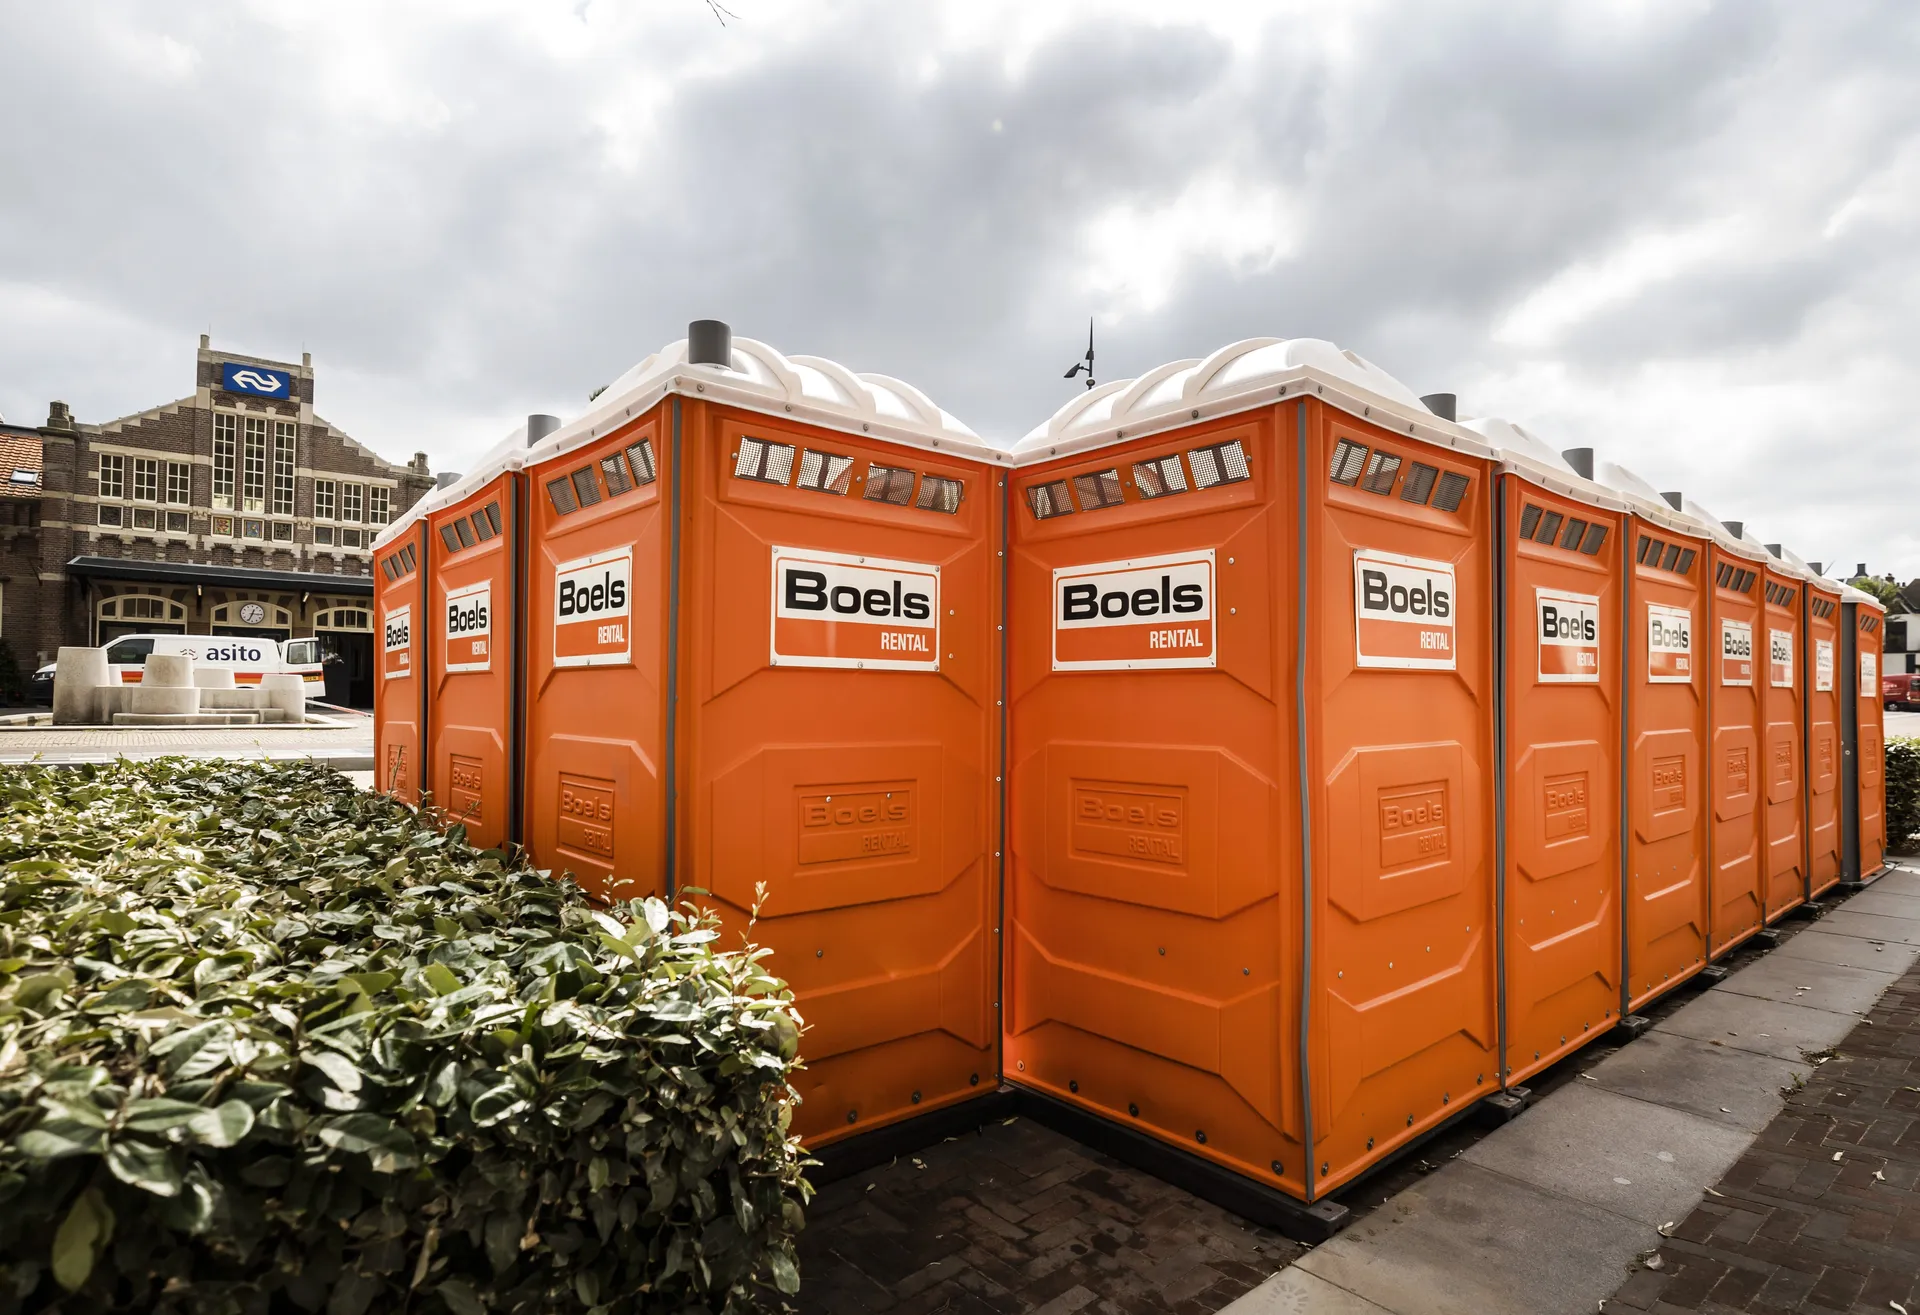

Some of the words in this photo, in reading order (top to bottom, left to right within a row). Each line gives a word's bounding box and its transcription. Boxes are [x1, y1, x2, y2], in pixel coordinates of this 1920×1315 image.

[559, 571, 626, 617] Boels
[785, 568, 930, 620] Boels
[1063, 575, 1204, 621] Boels
[1362, 569, 1450, 618] Boels
[448, 600, 488, 633] Boels
[1542, 605, 1595, 641] Boels
[386, 620, 409, 647] Boels
[597, 623, 625, 645] RENTAL
[880, 632, 929, 652] RENTAL
[1149, 628, 1203, 649] RENTAL
[1420, 631, 1449, 651] RENTAL
[1652, 620, 1689, 648] Boels
[1724, 632, 1750, 656] Boels
[206, 643, 261, 662] asito
[562, 789, 611, 821] Boels
[1546, 786, 1585, 810] Boels
[803, 801, 908, 828] Boels
[1078, 799, 1178, 829] Boels
[1382, 800, 1444, 830] Boels
[862, 833, 909, 853] RENTAL
[1128, 834, 1181, 858] RENTAL
